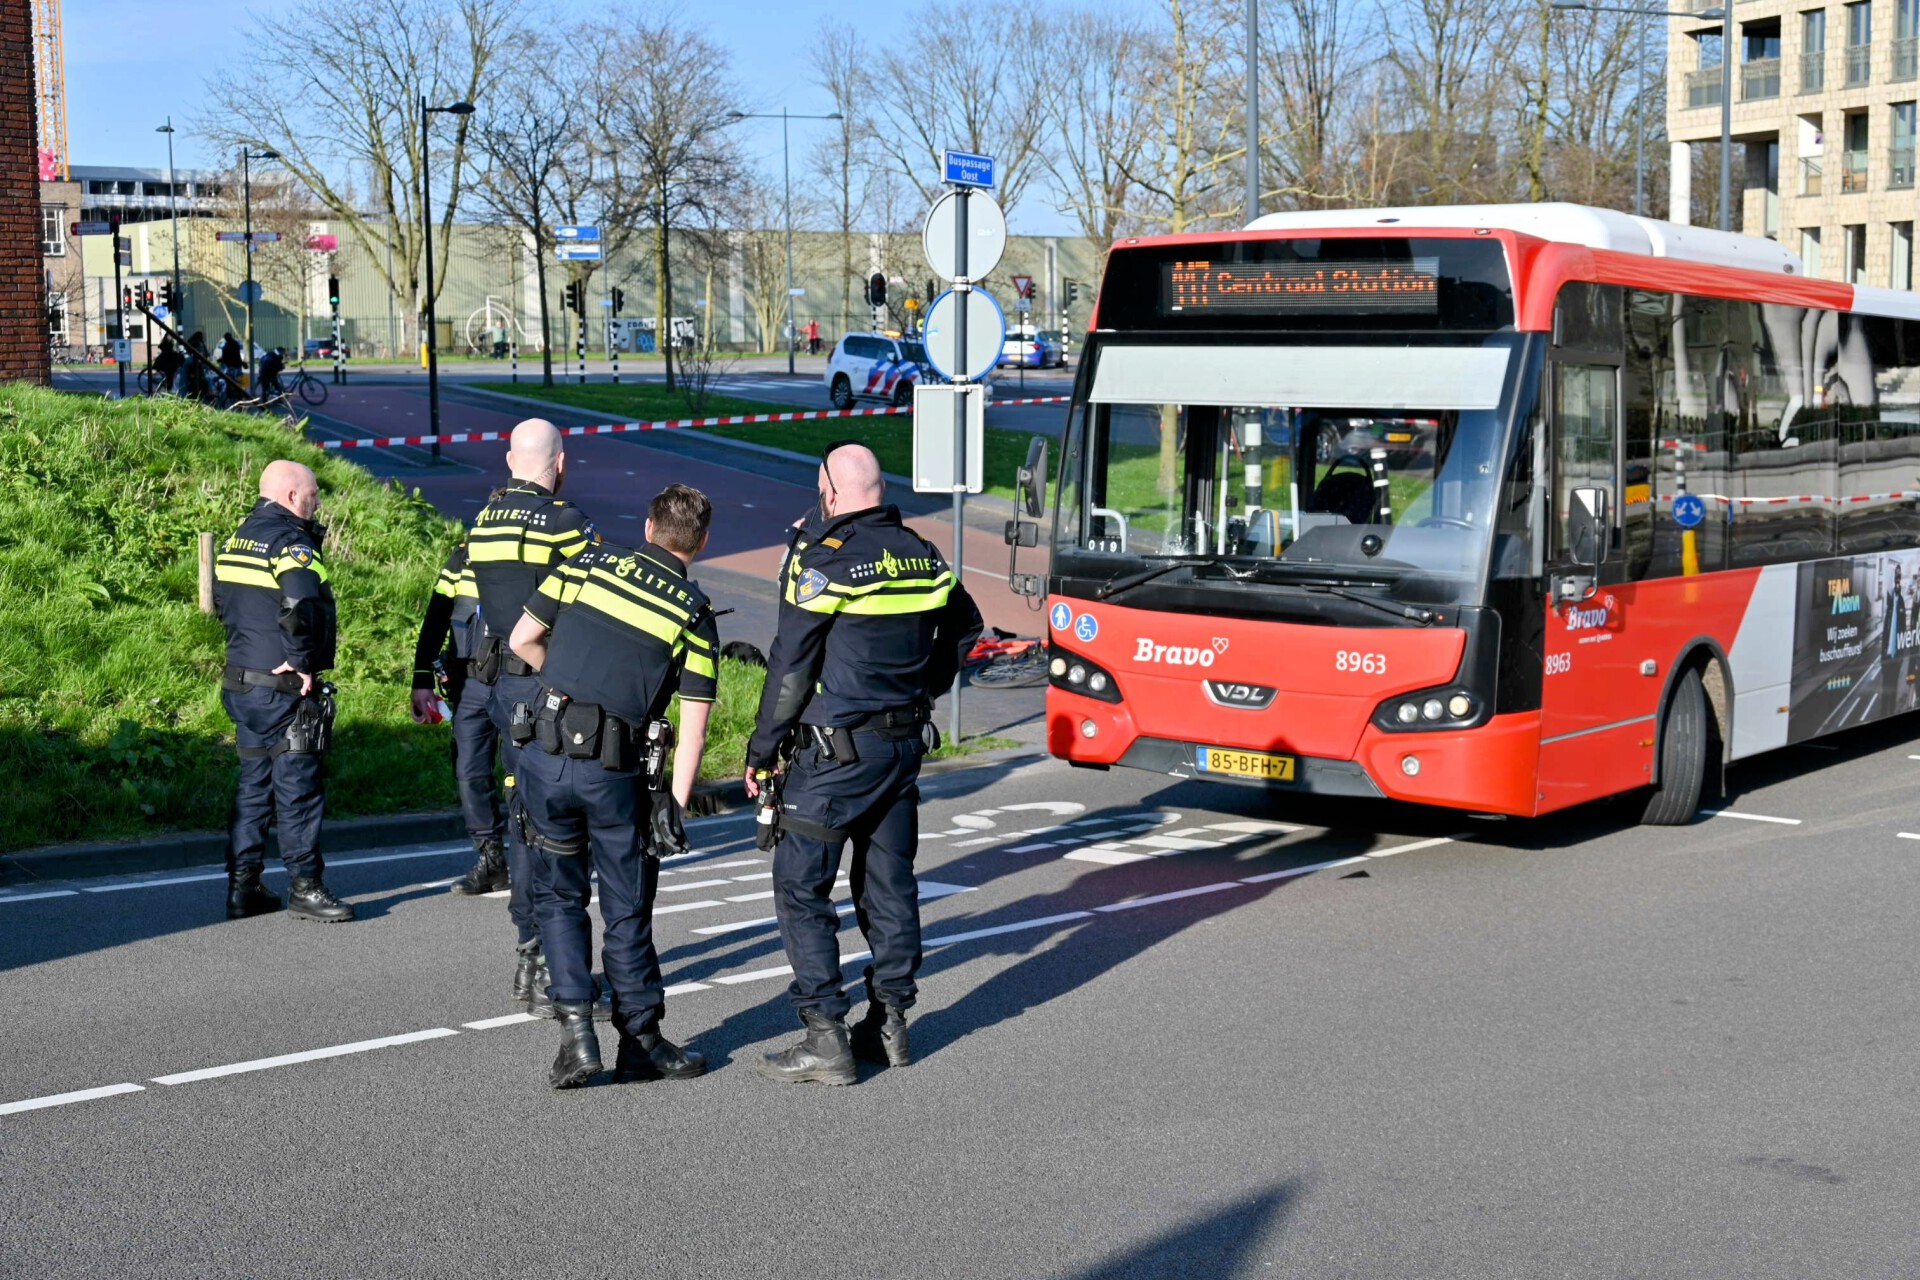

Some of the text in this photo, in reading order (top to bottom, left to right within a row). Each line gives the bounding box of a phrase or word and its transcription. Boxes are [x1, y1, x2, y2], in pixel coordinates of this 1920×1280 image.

[948, 155, 991, 172] Buspassage
[961, 169, 979, 181] Oost
[874, 548, 932, 578] POLITIE
[605, 554, 689, 602] POLITIE
[1828, 578, 1850, 597] TEAM
[1566, 606, 1607, 631] Bravo
[1827, 624, 1858, 644] Wij zoeken
[1133, 638, 1214, 667] Bravo
[1336, 650, 1386, 675] 8963
[1545, 652, 1571, 675] 8963
[1217, 684, 1264, 701] VDL
[1212, 752, 1287, 776] 85-BFH-7
